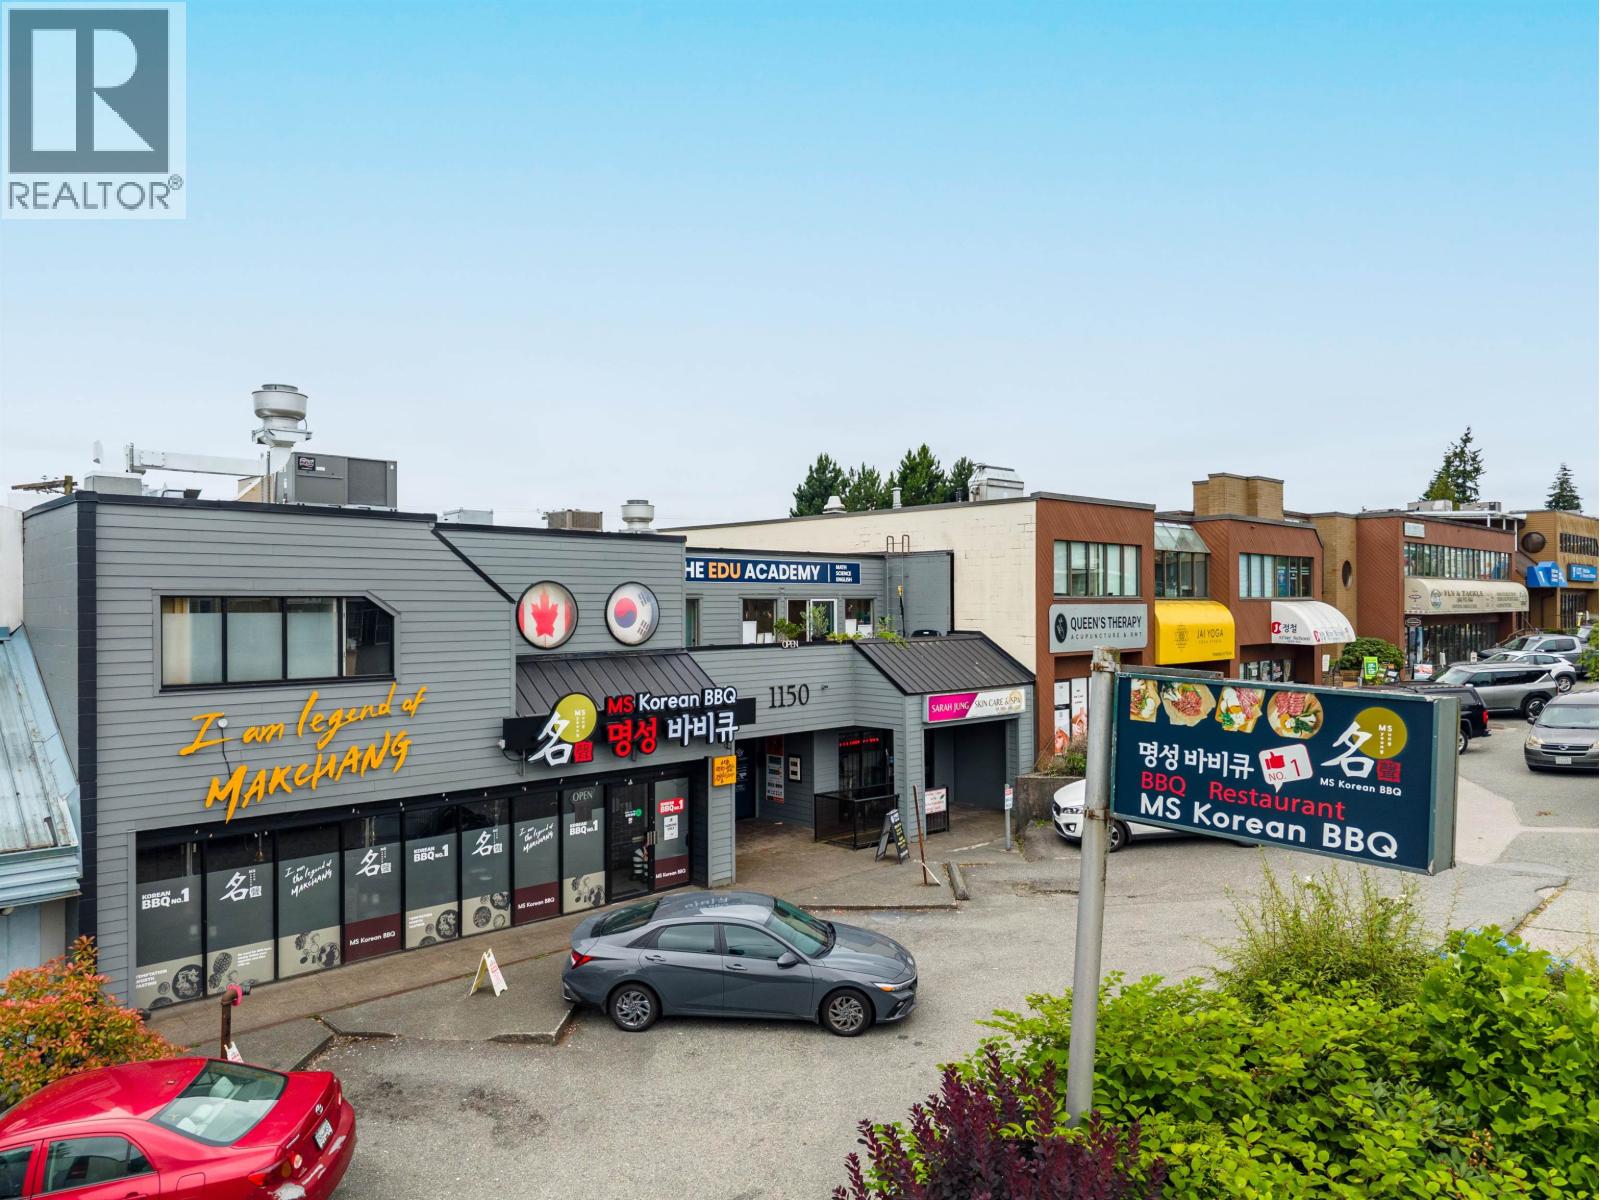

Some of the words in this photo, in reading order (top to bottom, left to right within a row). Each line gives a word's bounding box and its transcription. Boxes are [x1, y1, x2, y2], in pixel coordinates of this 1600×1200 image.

[685, 561, 705, 579] HE
[708, 562, 741, 579] EDU
[744, 563, 820, 580] ACADEMY
[1070, 616, 1106, 631] QUEEN'S
[1107, 615, 1142, 629] THERAPY
[1197, 628, 1206, 639] JAI
[1207, 628, 1224, 638] YOGA
[1282, 623, 1297, 633] 정철
[782, 639, 799, 649] OPEN
[1070, 632, 1120, 640] ACUPUNCTURE
[607, 695, 635, 715] MS
[639, 692, 700, 712] Korean
[704, 687, 737, 706] BBQ
[768, 683, 810, 709] 1150
[931, 703, 953, 713] SARAH
[953, 701, 970, 713] JUNG
[975, 700, 988, 708] SKIN
[988, 697, 1004, 706] CARE
[1004, 697, 1009, 705] &
[1010, 696, 1021, 704] SPA
[178, 712, 233, 756] I
[242, 722, 285, 744] am
[297, 682, 397, 751] legend
[402, 685, 428, 718] of
[527, 711, 573, 766] 名
[608, 716, 658, 757] 명성
[667, 711, 739, 746] 바비큐
[1320, 720, 1375, 779] 名
[1138, 741, 1179, 771] 명성
[1184, 748, 1255, 780] 바비큐
[1268, 771, 1287, 781] NO.
[1290, 758, 1300, 777] 1
[205, 729, 412, 824] MAKCHANG
[1320, 777, 1335, 787] MS
[1338, 780, 1376, 792] Korean
[1379, 785, 1402, 796] BBQ
[572, 790, 593, 802] OPEN
[1141, 771, 1186, 797] BBQ
[1209, 781, 1346, 820] Restaurant
[661, 804, 674, 813] BBQ
[569, 825, 587, 836] BBQ
[1140, 793, 1181, 820] MS
[1193, 801, 1306, 843] Korean
[1322, 822, 1398, 860] BBQ
[471, 830, 493, 856] 名
[355, 849, 381, 877] 名
[413, 851, 435, 863] BBQ
[284, 866, 295, 878] I
[291, 868, 332, 897] MAKCHANG
[292, 872, 304, 884] the
[304, 860, 326, 879] legend
[141, 890, 171, 900] KOREAN
[219, 871, 250, 902] 名
[141, 896, 170, 910] BBQ
[349, 938, 359, 946] MS
[360, 934, 382, 943] Korean
[382, 930, 396, 939] BBQ
